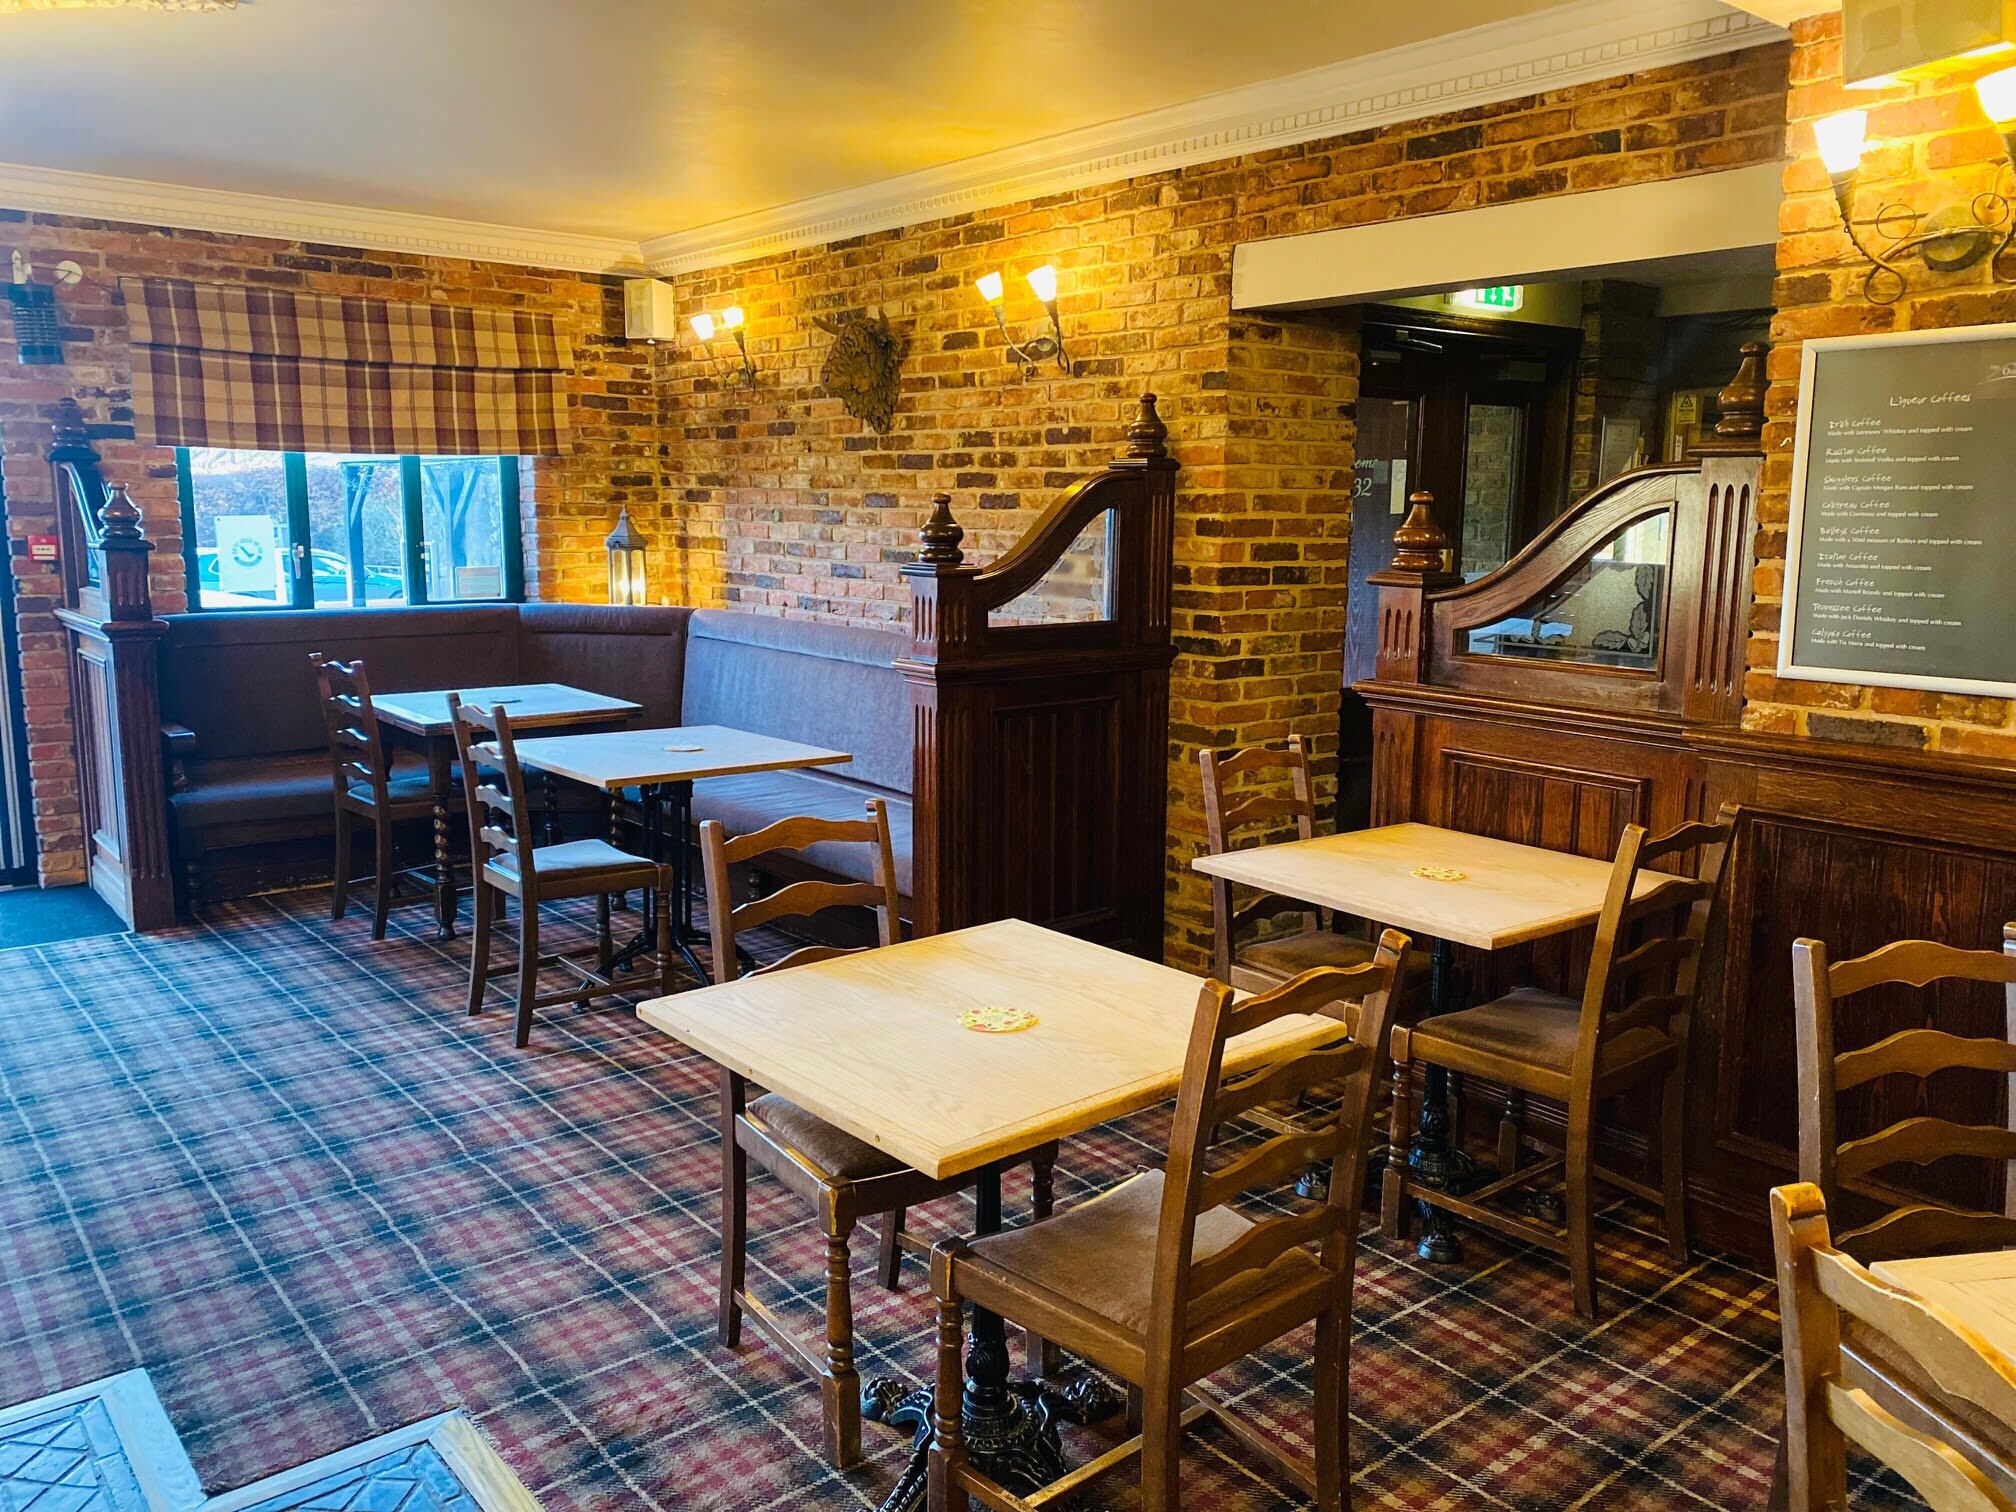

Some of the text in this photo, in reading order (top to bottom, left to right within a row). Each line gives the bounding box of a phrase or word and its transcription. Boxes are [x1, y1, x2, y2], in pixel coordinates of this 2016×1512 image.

[1890, 395, 1927, 408] Liqueur
[1829, 418, 1849, 429] Irish
[1353, 477, 1372, 498] 32
[1816, 577, 1843, 586] French
